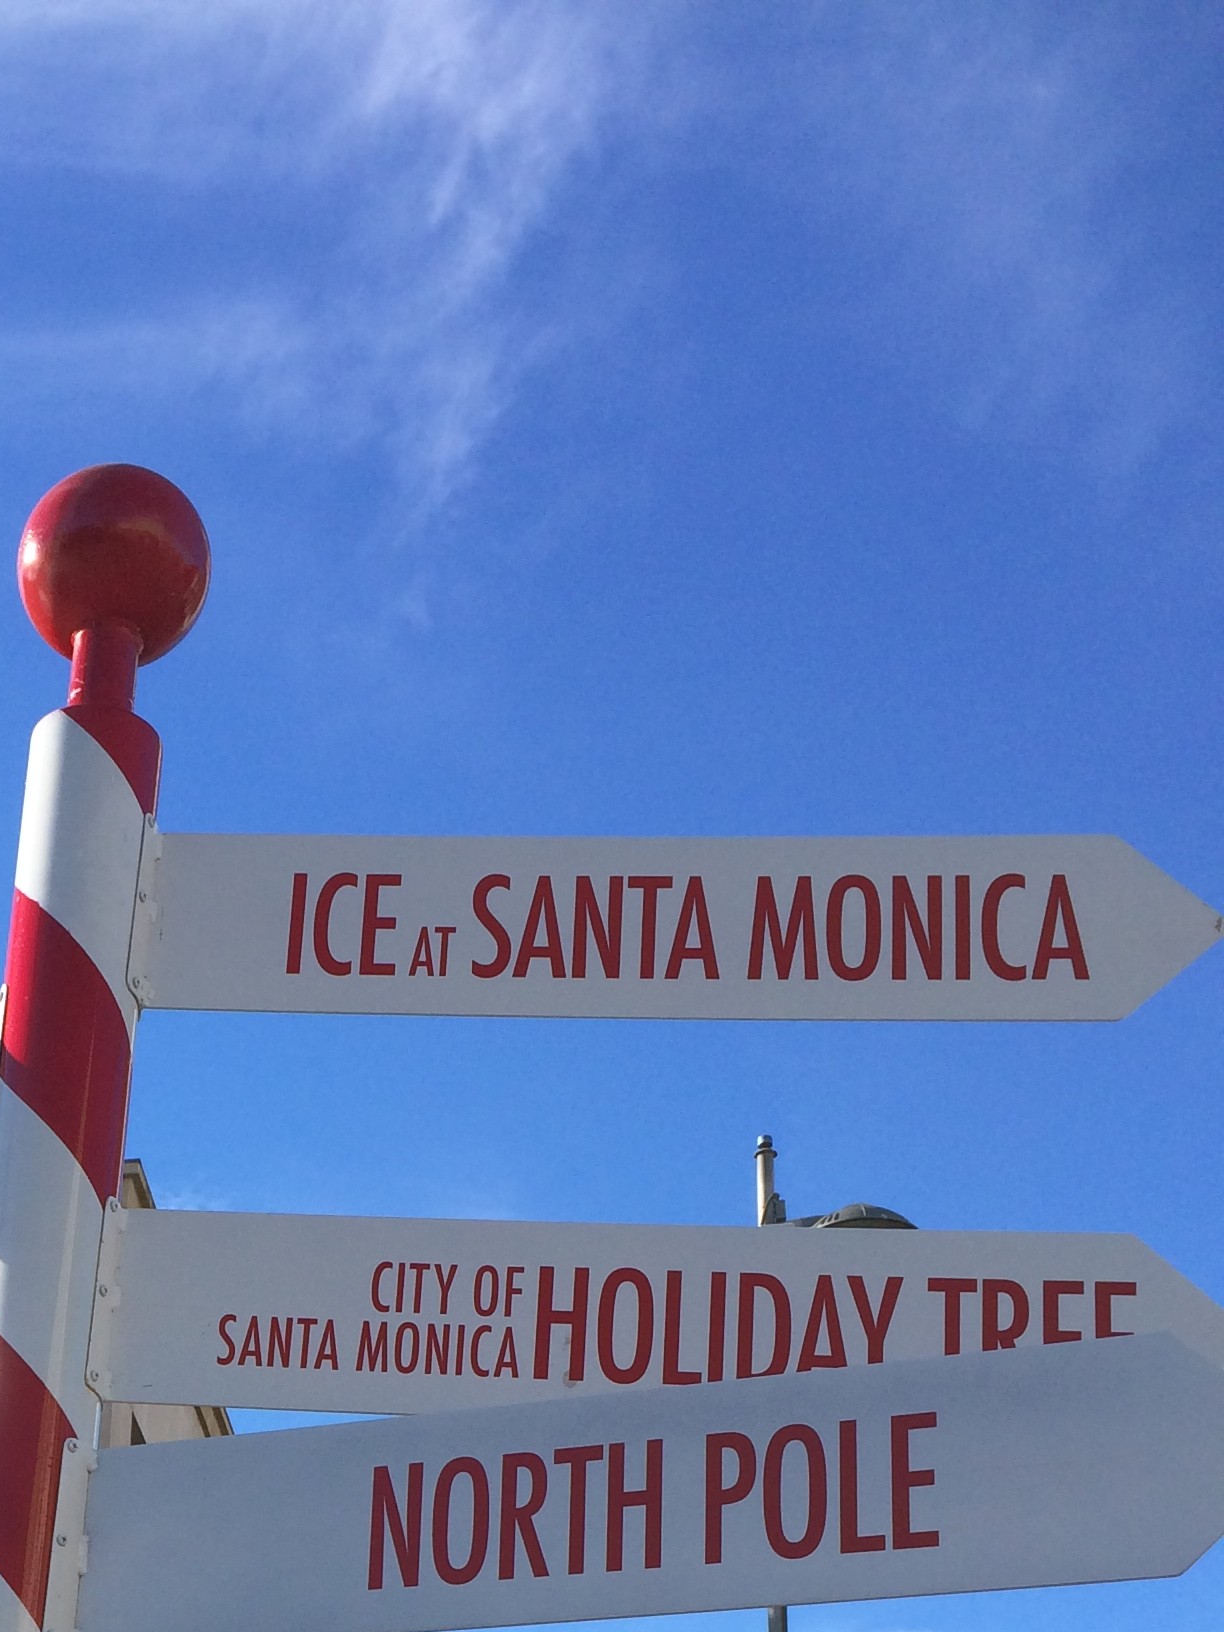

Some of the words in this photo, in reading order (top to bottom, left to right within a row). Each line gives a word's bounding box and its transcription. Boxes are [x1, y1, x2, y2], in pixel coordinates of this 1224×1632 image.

[285, 873, 402, 977] ICE
[408, 927, 456, 977] AT
[471, 874, 720, 981] SANTA
[747, 873, 1090, 981] MONICA
[370, 1261, 458, 1315] CITY
[473, 1265, 525, 1318] OF
[532, 1266, 904, 1386] HOLIDAY
[216, 1313, 339, 1370] SANTA
[355, 1321, 519, 1379] MONICA
[368, 1439, 664, 1591] NORTH
[705, 1412, 940, 1565] POLE
